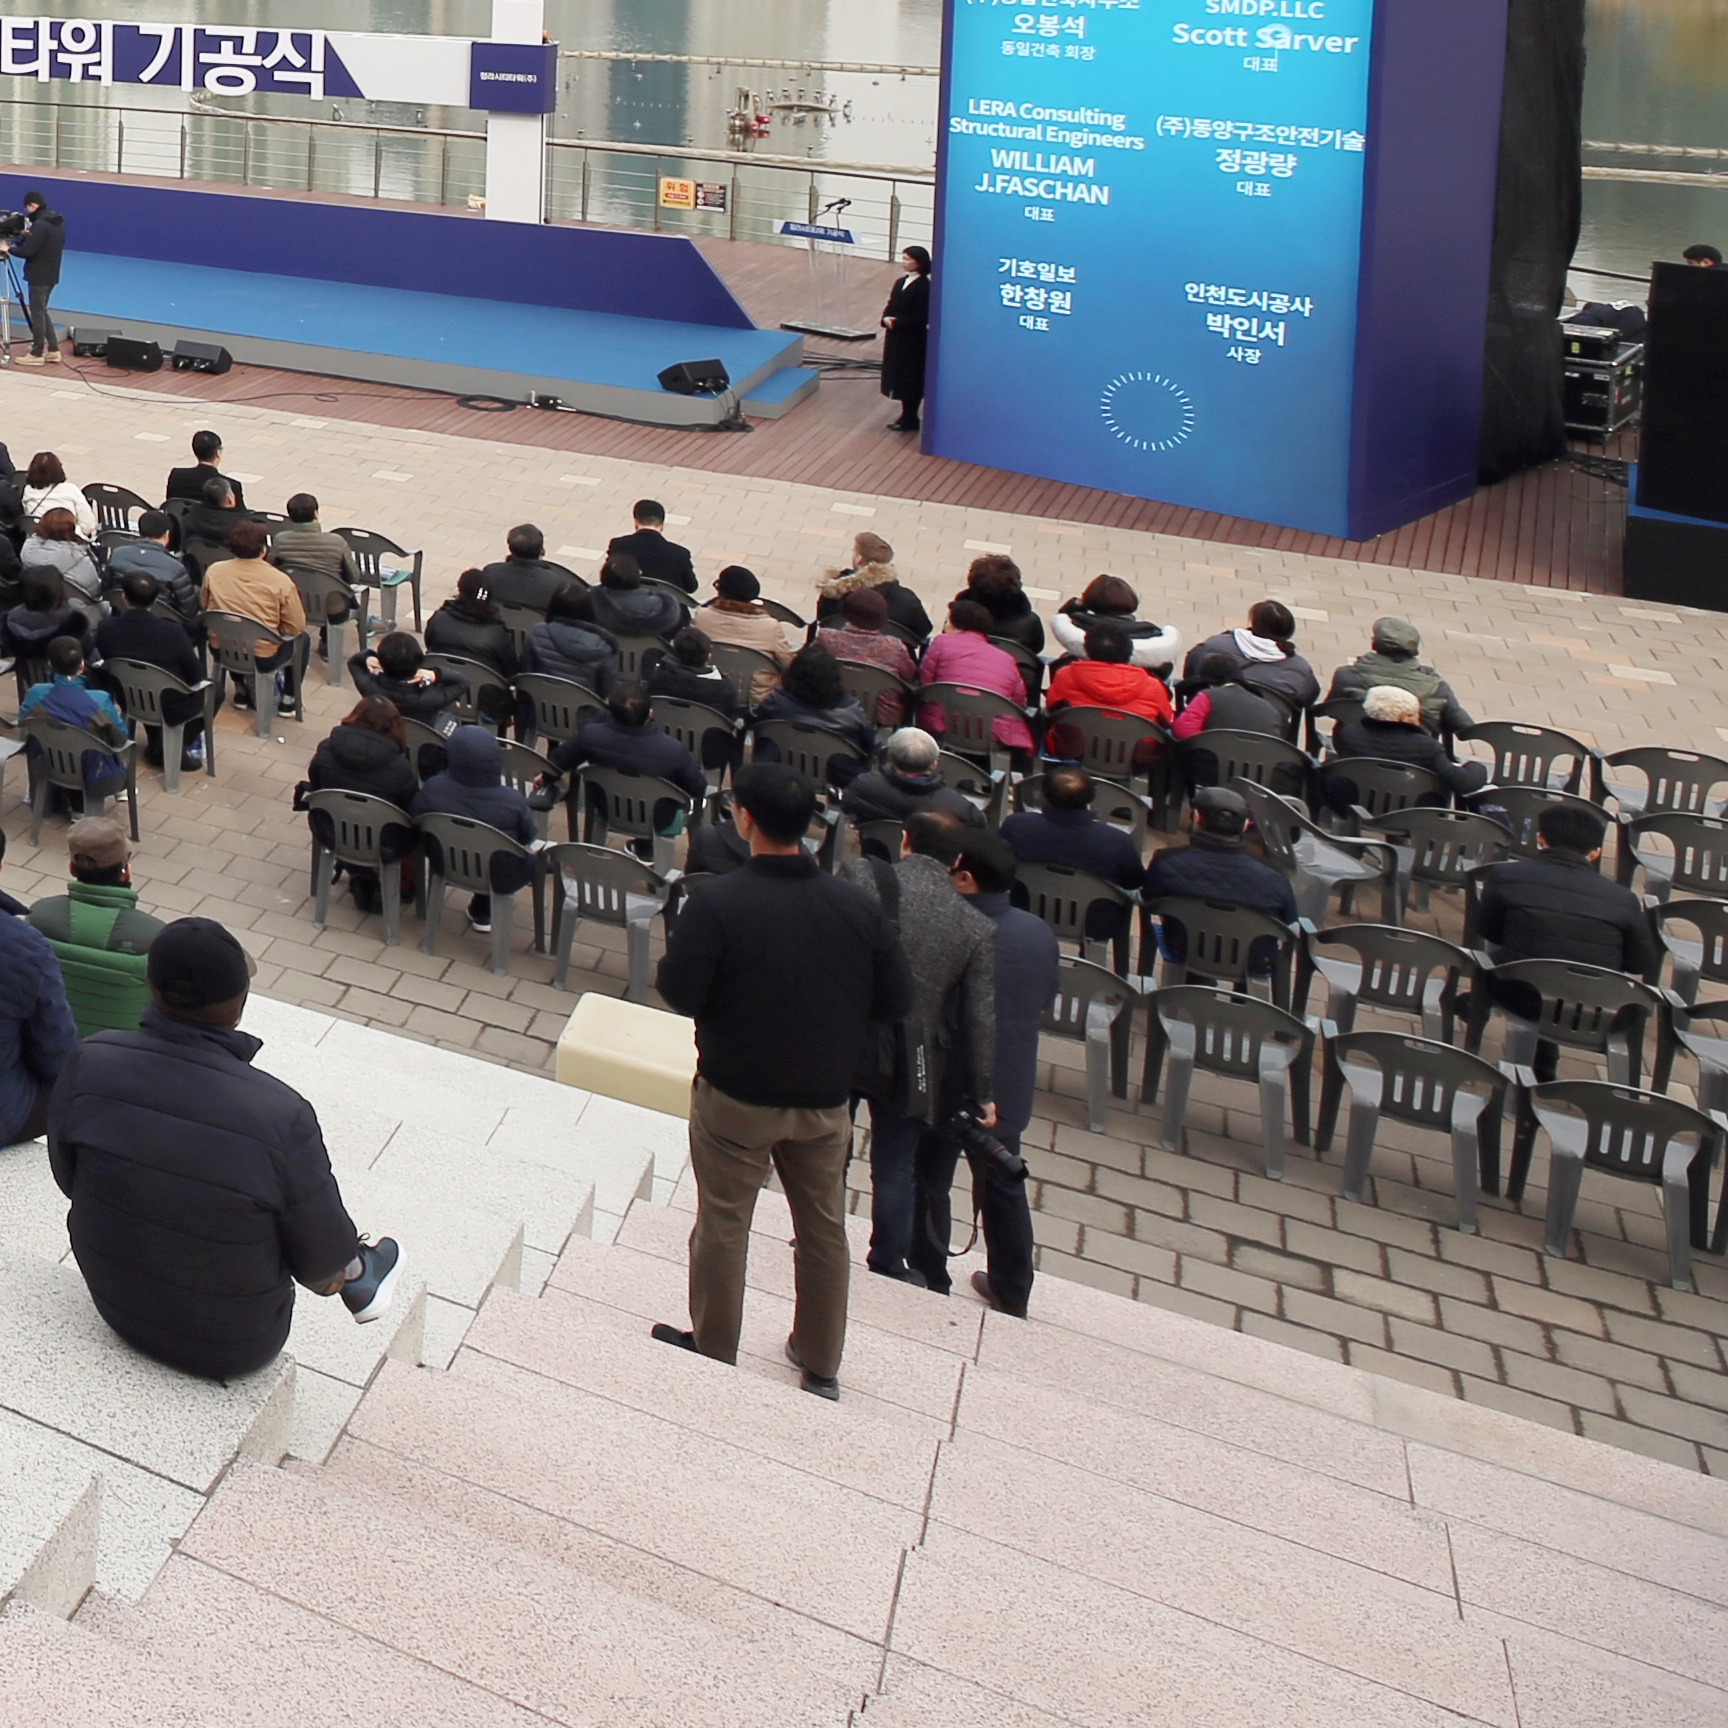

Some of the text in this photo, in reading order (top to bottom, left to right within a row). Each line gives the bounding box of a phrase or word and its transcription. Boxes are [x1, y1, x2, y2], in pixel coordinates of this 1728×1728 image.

[1011, 13, 1086, 40] 오봉석
[1172, 23, 1359, 54] Scott Sarver
[138, 22, 326, 101] 기공식
[1001, 40, 1096, 61] 동일건축 회장
[1243, 56, 1278, 73] 대표
[968, 98, 1126, 131] LERA Consulting
[949, 116, 1145, 151] Structural Engineers
[1155, 114, 1366, 152] (주)동양구조안전기술
[990, 148, 1095, 178] WILLIAM
[1215, 148, 1298, 178] 정광량
[974, 173, 1109, 205] J.FASCHAN
[1236, 180, 1272, 197] 대표
[1024, 206, 1055, 222] 대표
[998, 258, 1076, 284] 기호일보
[999, 282, 1072, 315] 한창원
[1184, 282, 1313, 318] 인천도시공사
[1019, 315, 1050, 332] 대표
[1205, 312, 1286, 346] 박인서
[1226, 345, 1262, 365] 사장
